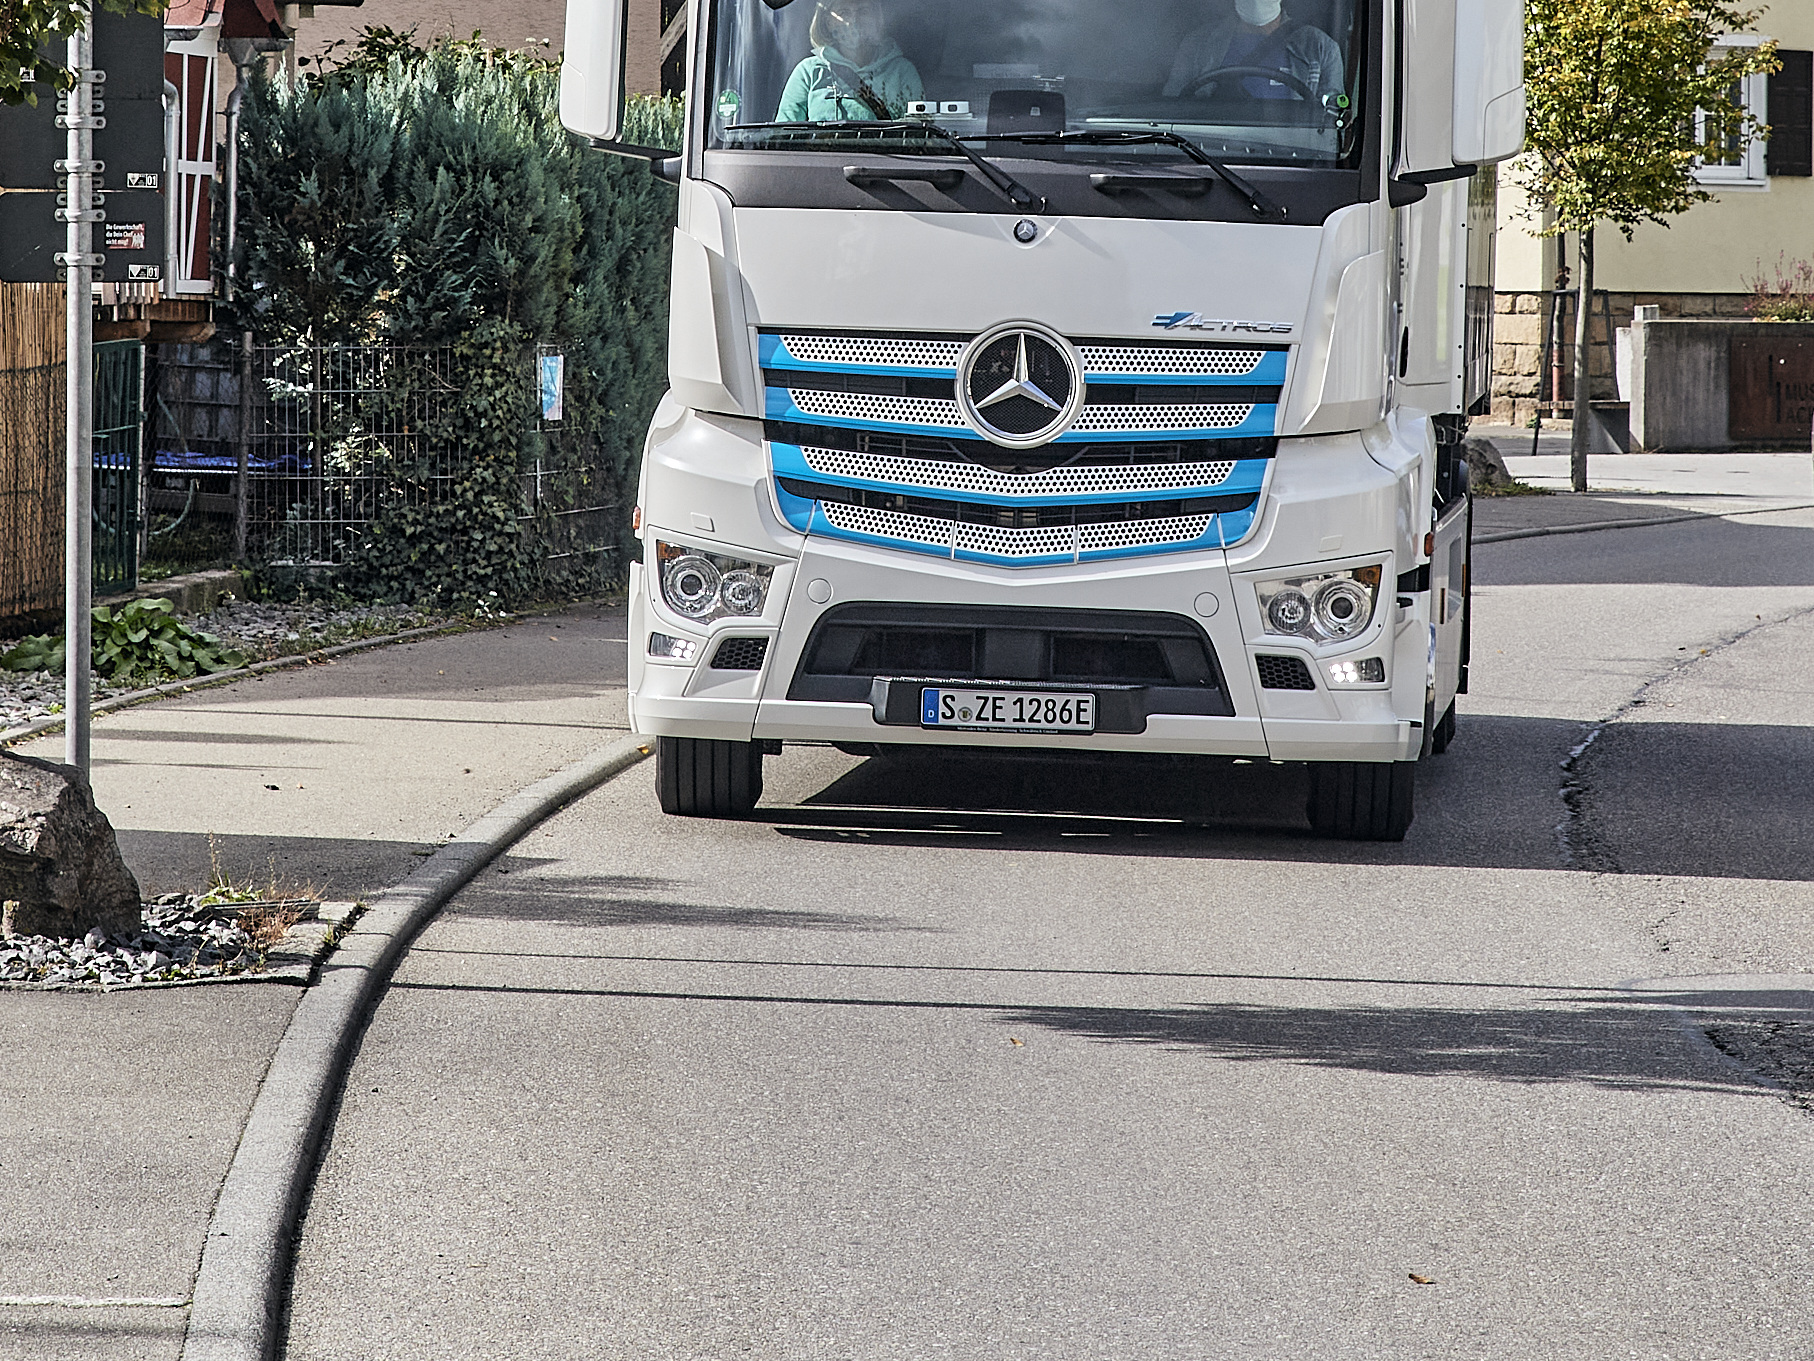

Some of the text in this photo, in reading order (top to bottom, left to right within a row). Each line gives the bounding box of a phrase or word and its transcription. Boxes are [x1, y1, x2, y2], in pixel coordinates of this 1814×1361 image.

[1164, 311, 1294, 334] ACTROS
[927, 709, 935, 718] D
[941, 694, 1090, 725] S ZE 1286E
